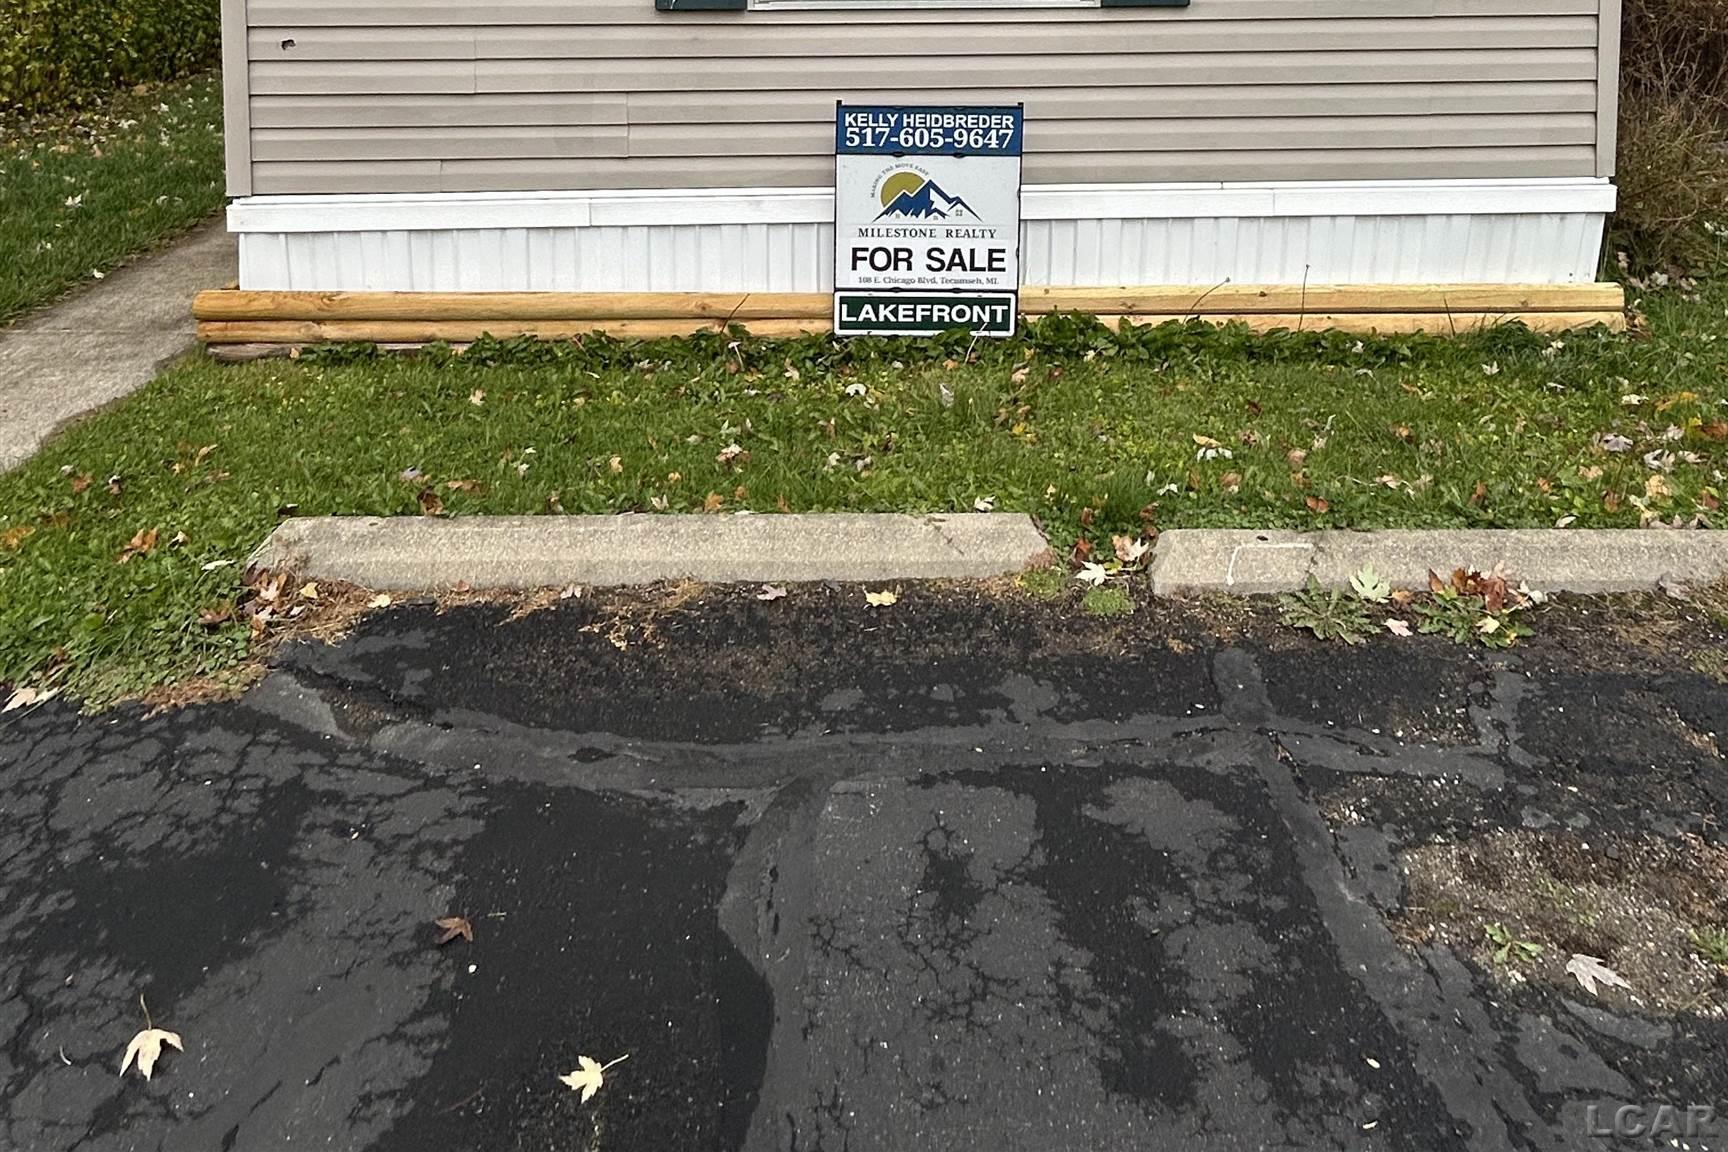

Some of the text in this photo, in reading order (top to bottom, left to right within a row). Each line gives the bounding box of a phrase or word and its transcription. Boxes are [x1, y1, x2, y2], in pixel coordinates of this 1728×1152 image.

[844, 113, 1014, 129] KELLY HEIDBREDER
[845, 128, 1013, 149] 517-605-9647
[858, 227, 997, 239] MILESTONE REALTY
[851, 247, 1006, 273] FOR SALE
[858, 276, 872, 284] 108
[883, 276, 916, 285] Chicago
[940, 276, 984, 286] Tecumseh,
[841, 304, 1009, 323] LAKEFRONT
